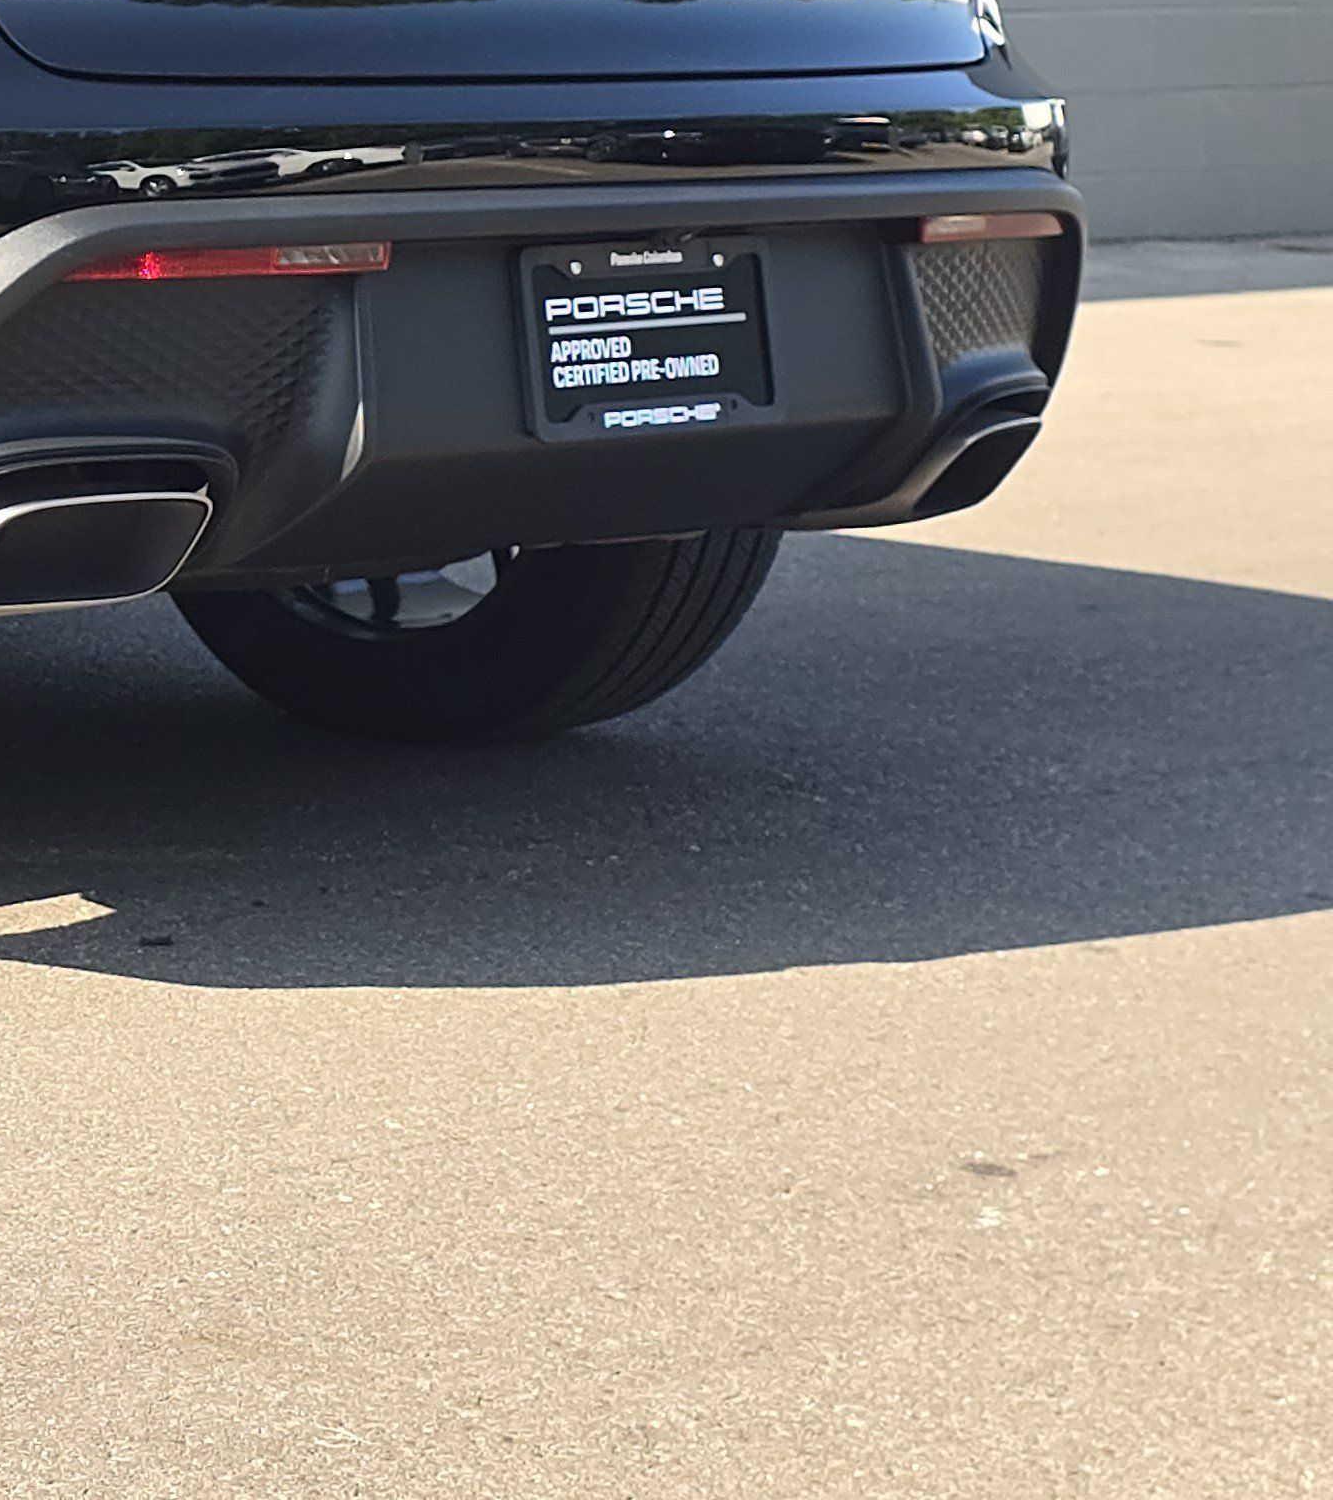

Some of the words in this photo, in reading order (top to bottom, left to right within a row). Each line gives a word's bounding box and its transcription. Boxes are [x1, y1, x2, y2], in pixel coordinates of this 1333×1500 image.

[544, 287, 725, 322] PORSCHE
[550, 336, 632, 363] APPROVED
[552, 361, 630, 389] CERTIFIED
[630, 353, 720, 383] PRE-OWNED
[603, 402, 721, 429] PORSCHE
